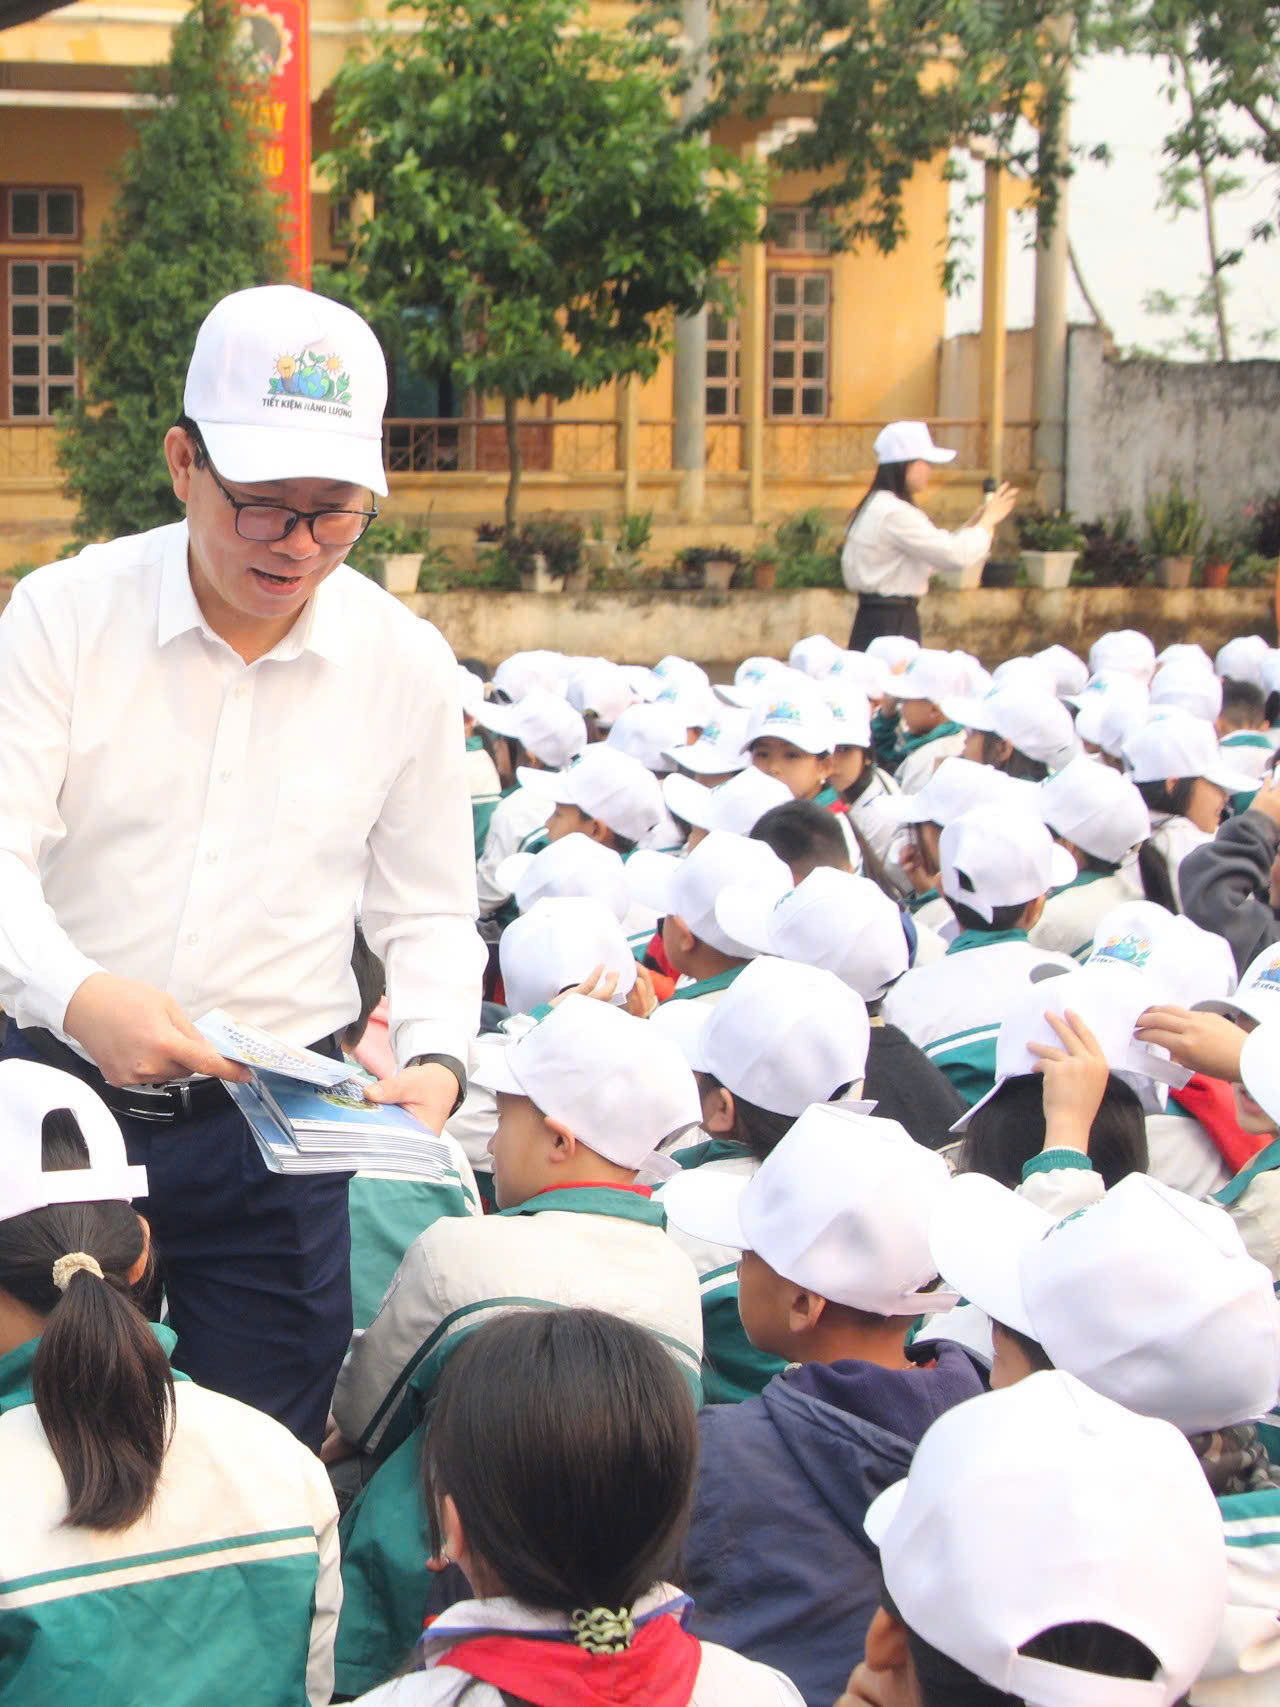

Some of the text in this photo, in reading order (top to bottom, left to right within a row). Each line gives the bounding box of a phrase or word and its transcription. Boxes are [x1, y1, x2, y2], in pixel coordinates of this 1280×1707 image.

[262, 395, 280, 408] TIẾT
[281, 398, 302, 411] KIỆM
[328, 406, 352, 418] LƯỢNG
